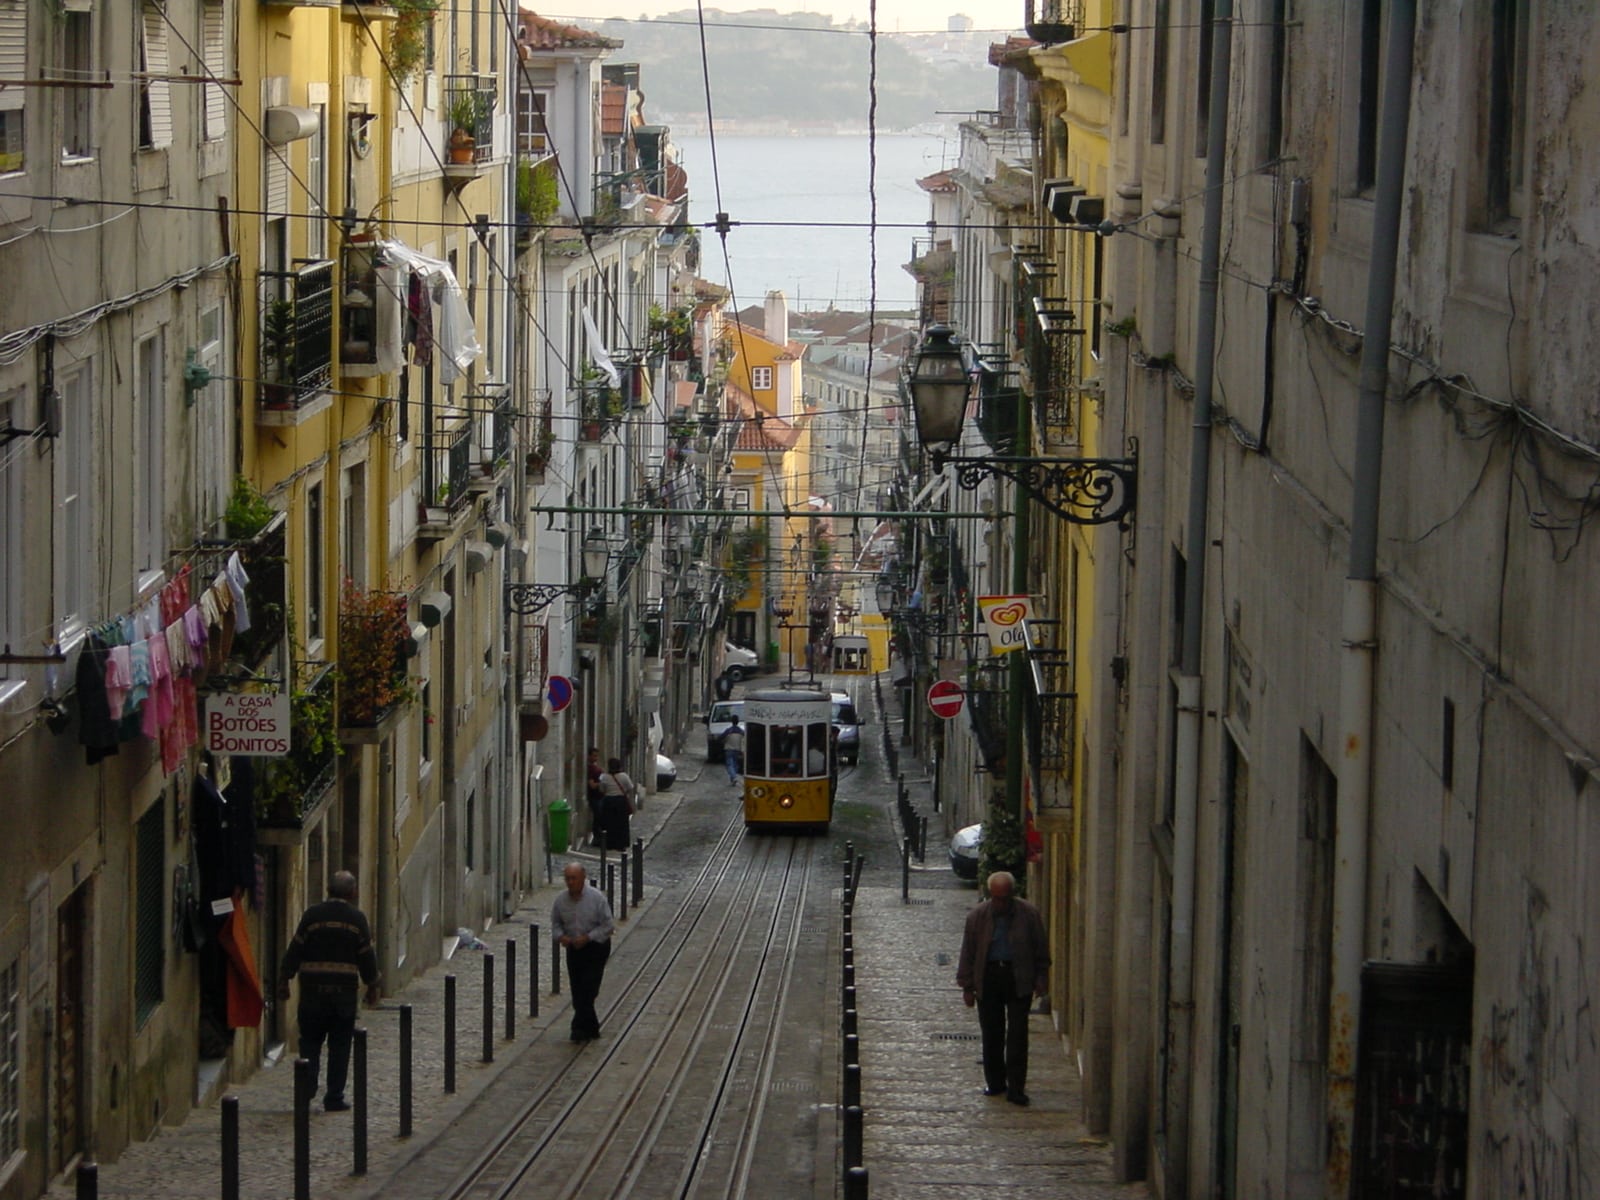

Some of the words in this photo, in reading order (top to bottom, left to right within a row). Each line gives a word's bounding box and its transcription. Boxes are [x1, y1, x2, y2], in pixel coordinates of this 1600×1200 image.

[225, 696, 235, 707] A
[239, 696, 273, 708] CASA
[238, 707, 260, 717] DOS
[209, 731, 288, 752] BONITOS
